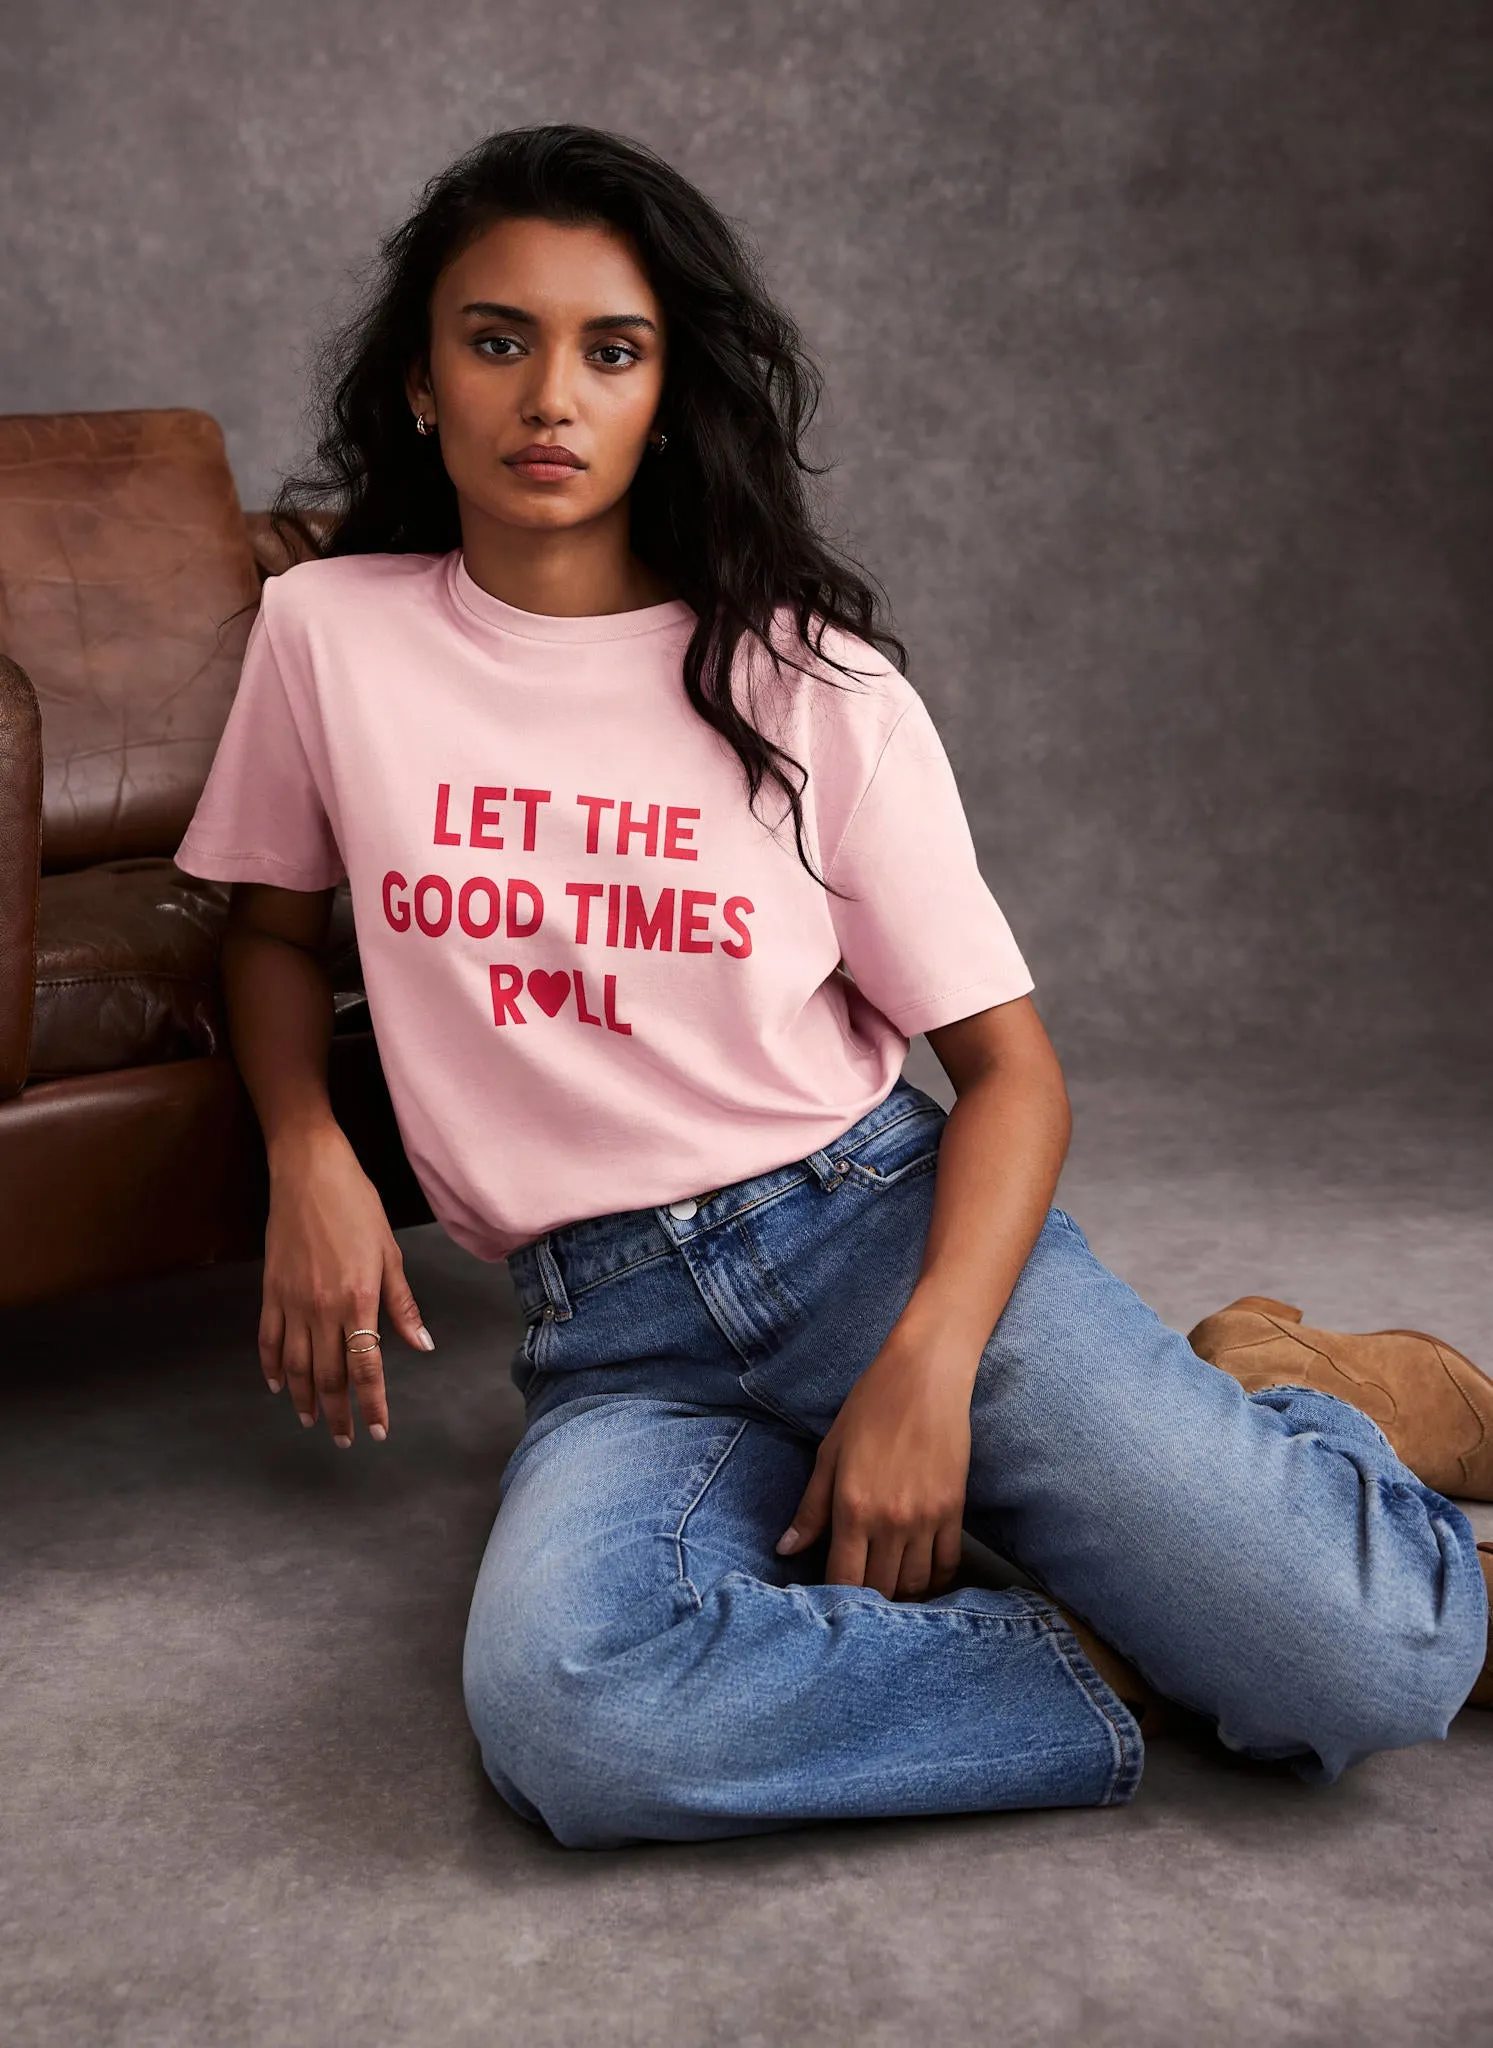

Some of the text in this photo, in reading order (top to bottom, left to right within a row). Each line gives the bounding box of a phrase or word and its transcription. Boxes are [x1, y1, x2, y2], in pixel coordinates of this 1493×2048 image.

[433, 783, 701, 861] LET THE
[382, 870, 755, 959] GOOD TIMES
